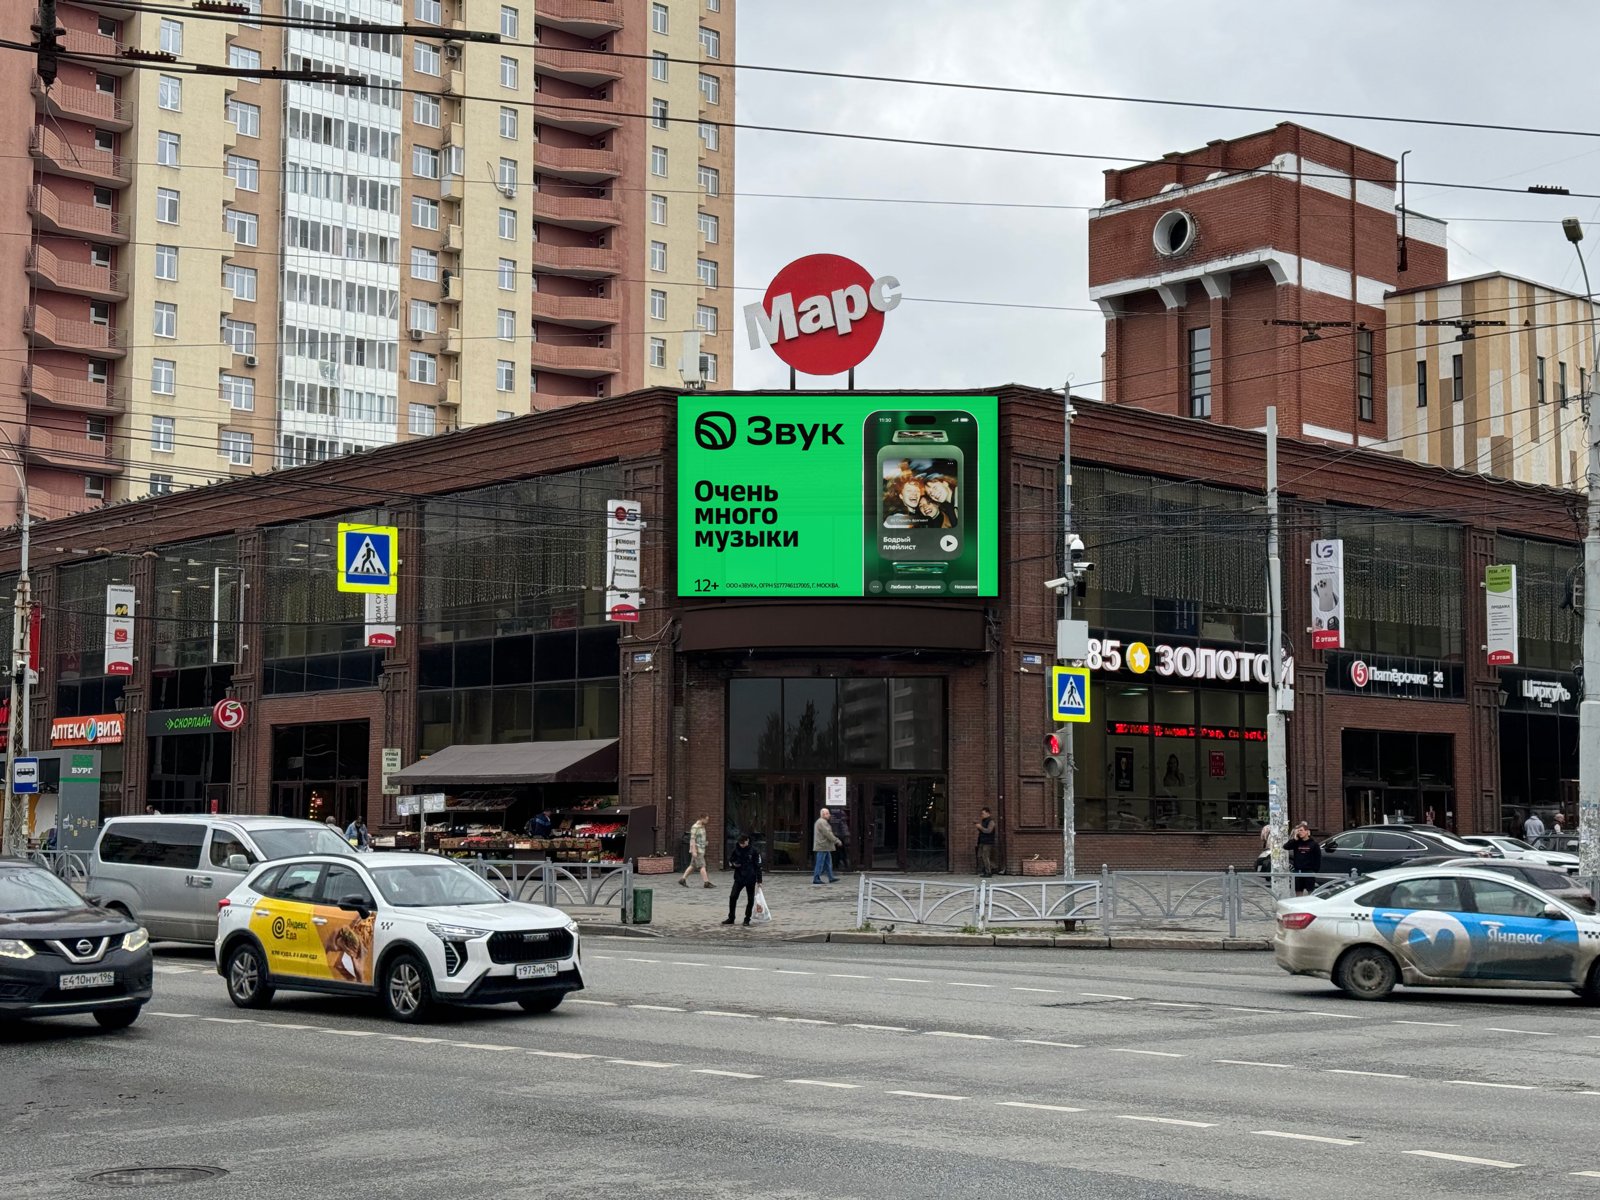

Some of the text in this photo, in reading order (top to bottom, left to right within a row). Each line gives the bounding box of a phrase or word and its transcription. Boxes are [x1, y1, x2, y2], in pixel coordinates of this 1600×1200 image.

[743, 275, 902, 350] Марс
[746, 416, 845, 451] Звук
[694, 480, 779, 502] Очень
[694, 508, 778, 525] много
[694, 531, 799, 552] музыки
[883, 536, 911, 544] Бодрый
[694, 579, 719, 592] 12+
[1369, 667, 1427, 686] Пятёрочка
[51, 720, 121, 740] АПТЕКА ВИТА
[174, 714, 211, 729] СКОРЛАЙН
[286, 919, 308, 930] Яндекс
[286, 930, 297, 940] Еда
[1488, 928, 1543, 945] Яндекс
